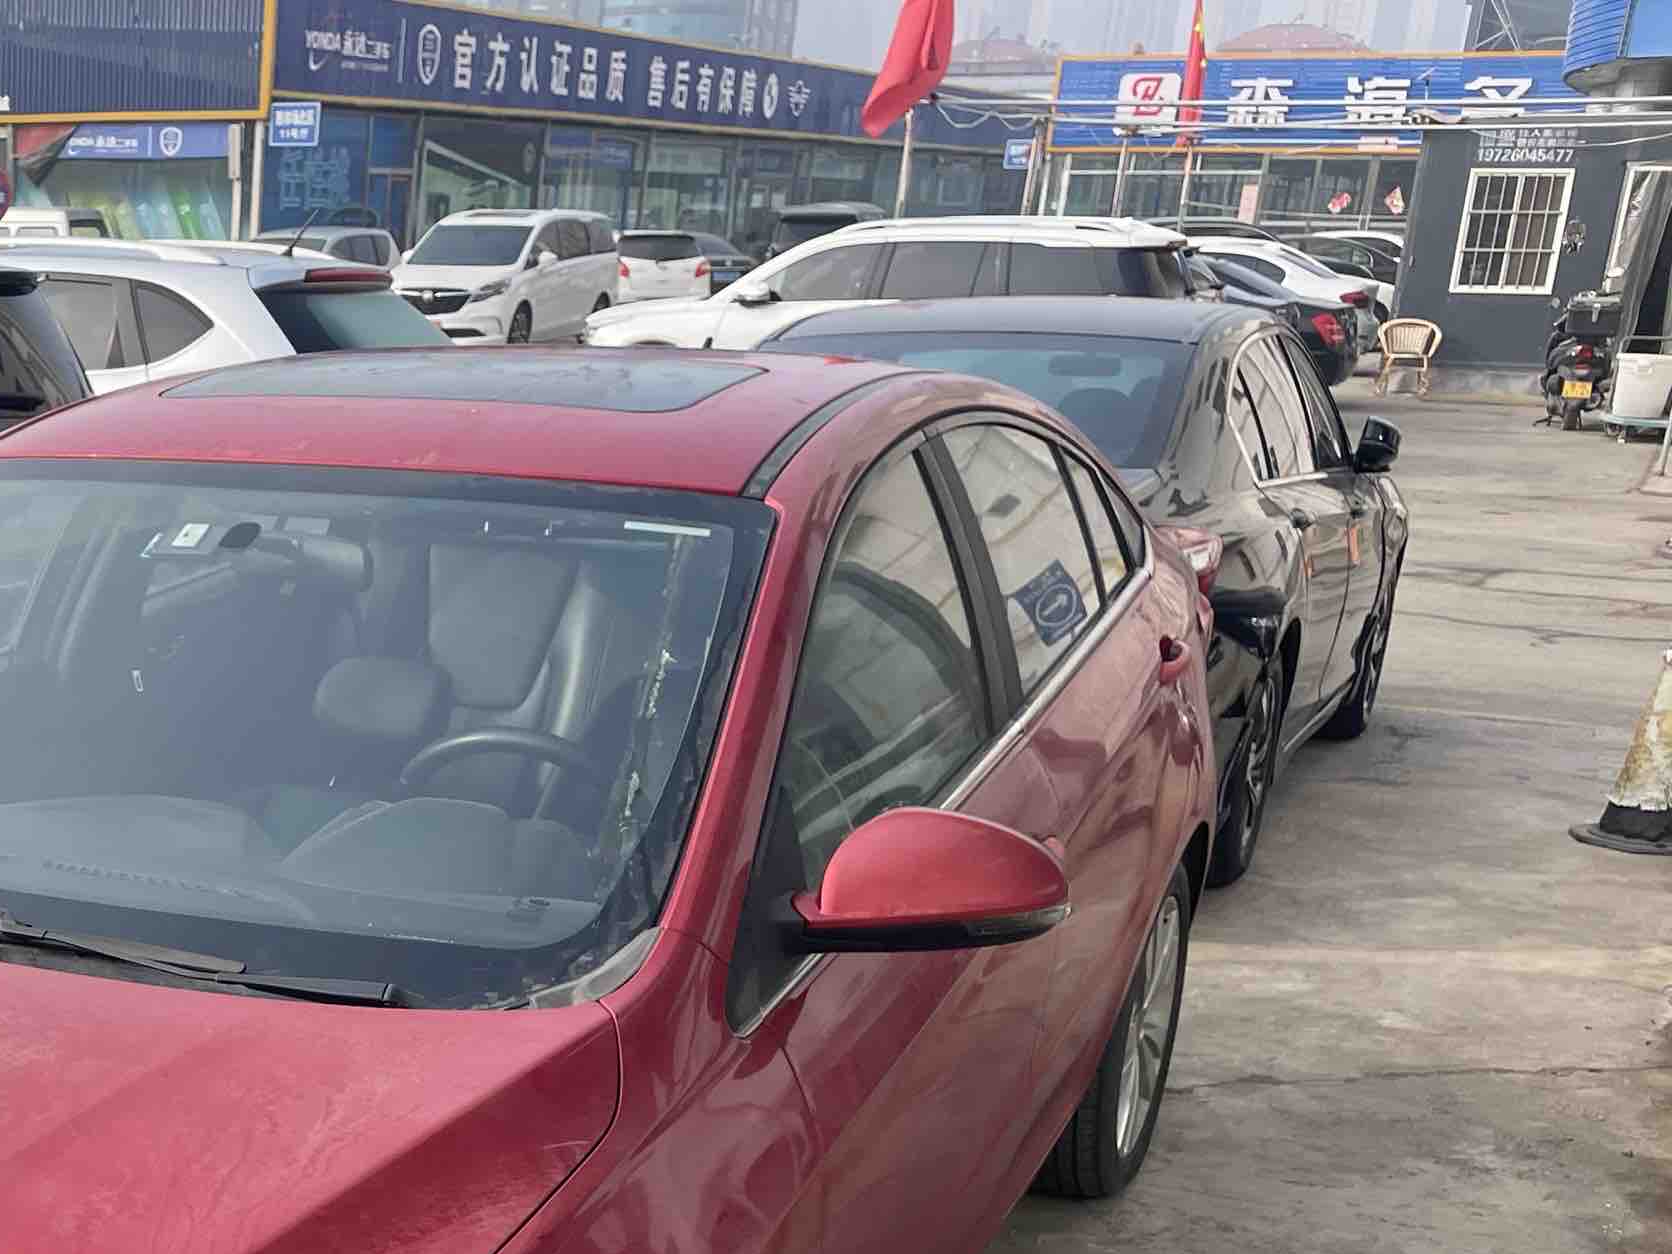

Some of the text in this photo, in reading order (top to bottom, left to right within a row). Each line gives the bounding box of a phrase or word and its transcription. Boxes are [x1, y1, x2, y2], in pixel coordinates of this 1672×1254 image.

[453, 28, 627, 103] 官方认证品质
[647, 55, 757, 118] 售后有保障
